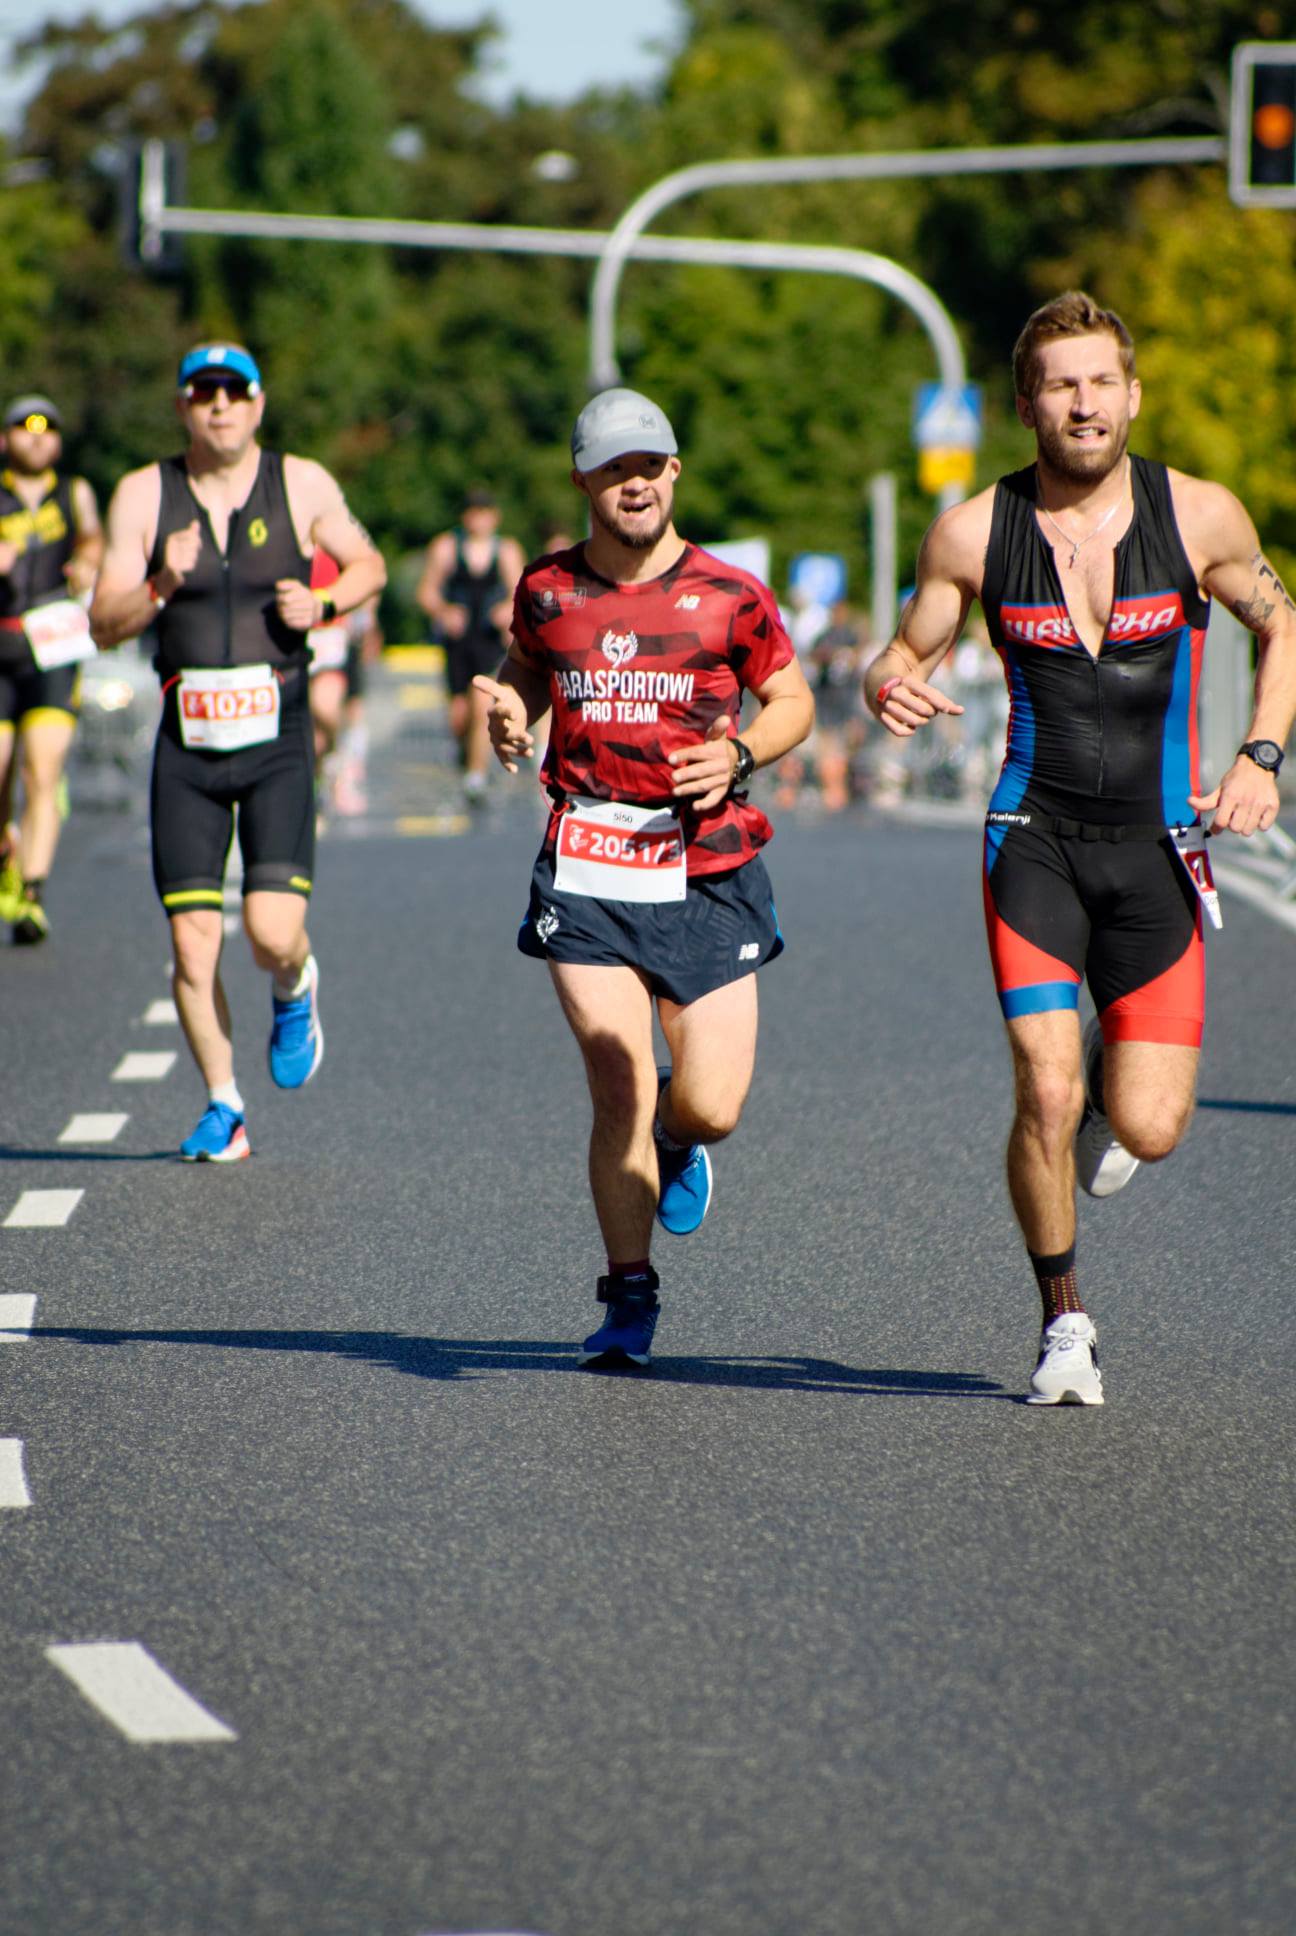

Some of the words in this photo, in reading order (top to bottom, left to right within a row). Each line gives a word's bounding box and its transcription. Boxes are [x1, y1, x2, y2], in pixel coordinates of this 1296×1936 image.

[555, 670, 695, 702] PARASPORTOWI
[202, 687, 273, 719] 1029
[582, 701, 612, 723] PRO
[615, 701, 659, 723] TEAM
